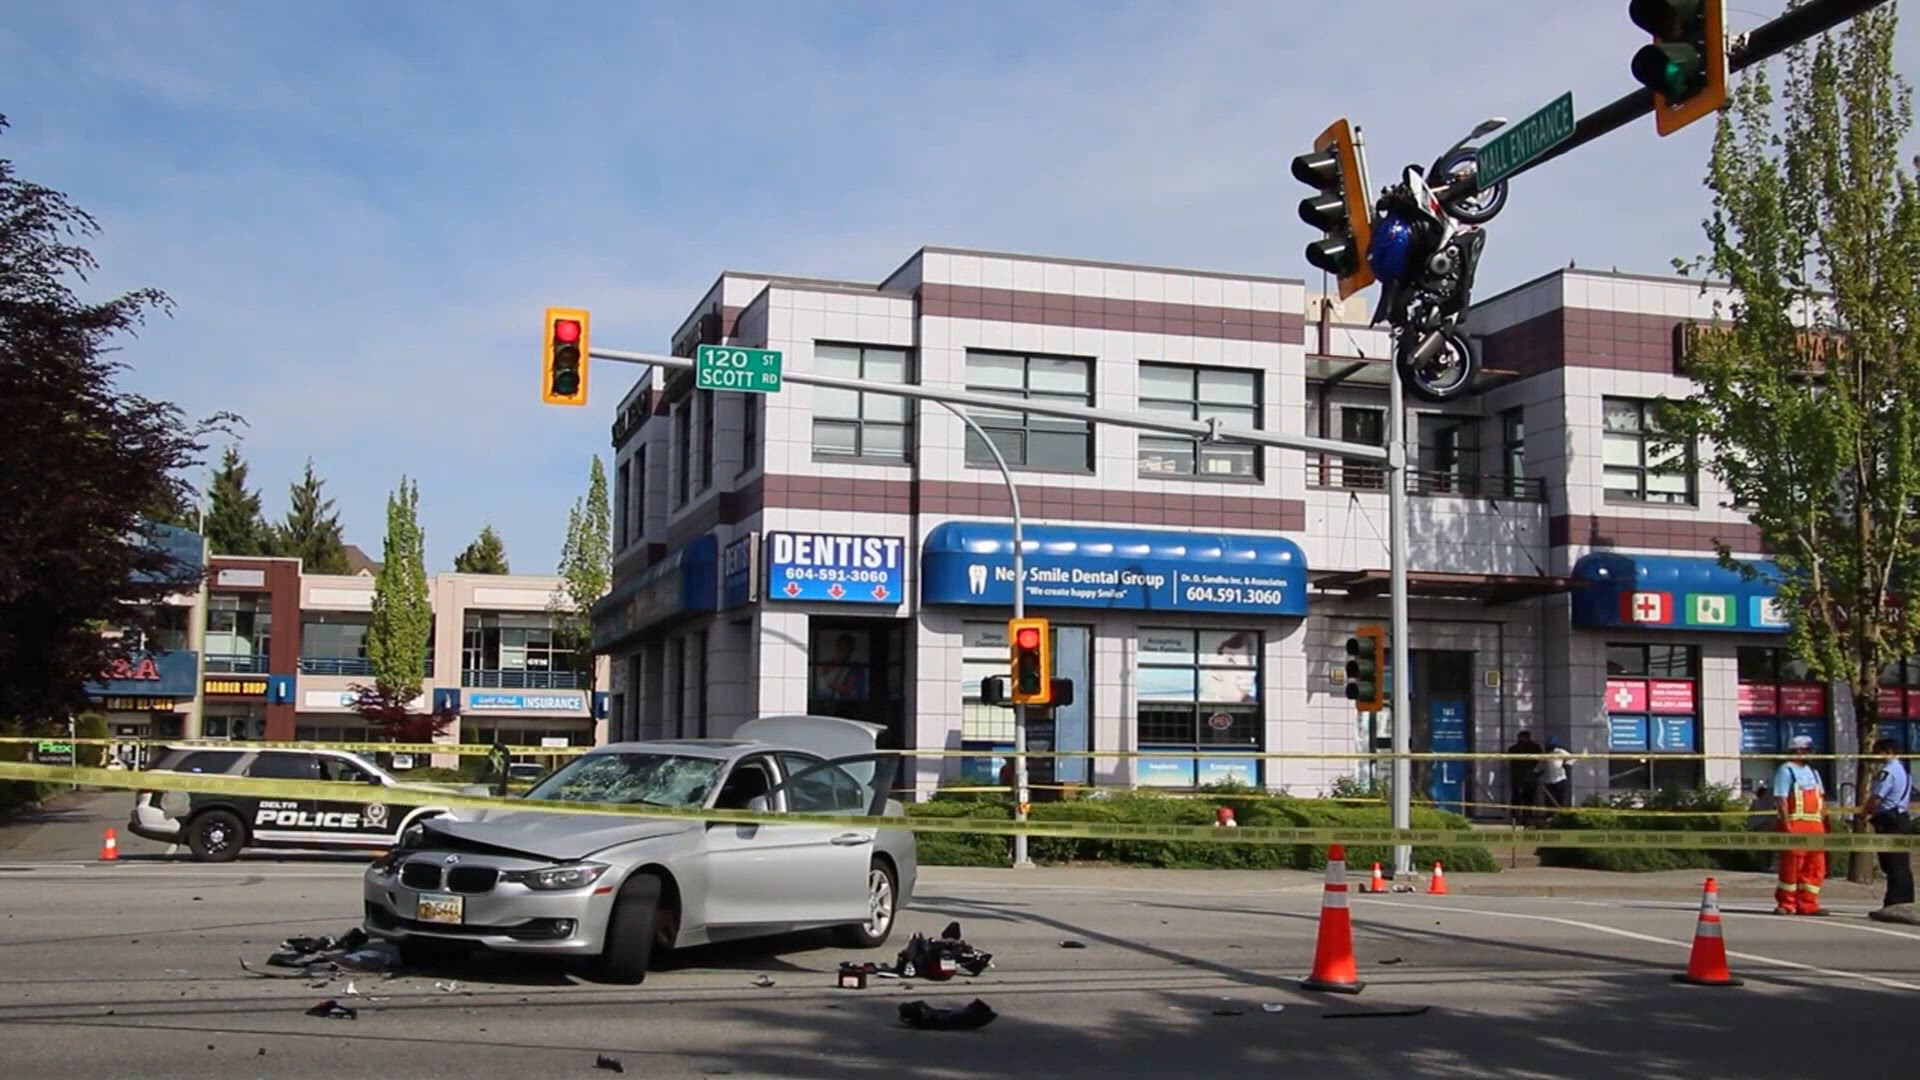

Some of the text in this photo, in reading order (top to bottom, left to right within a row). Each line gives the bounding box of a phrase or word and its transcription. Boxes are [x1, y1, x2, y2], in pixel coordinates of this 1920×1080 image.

[1480, 101, 1571, 182] MALL ENTRANCE
[705, 350, 774, 368] 120 ST
[702, 369, 777, 387] SCOTT RD
[774, 534, 900, 568] DENTIST
[785, 567, 888, 583] 604-591-3060
[1030, 567, 1069, 583] Smile
[1074, 568, 1119, 585] Dental
[1121, 571, 1164, 589] Group
[1044, 588, 1069, 596] create
[1071, 587, 1095, 600] happy
[1186, 586, 1281, 605] 604.591.3060
[523, 696, 580, 710] INSURANCE
[259, 801, 298, 809] DELTA
[255, 810, 360, 828] POLICE
